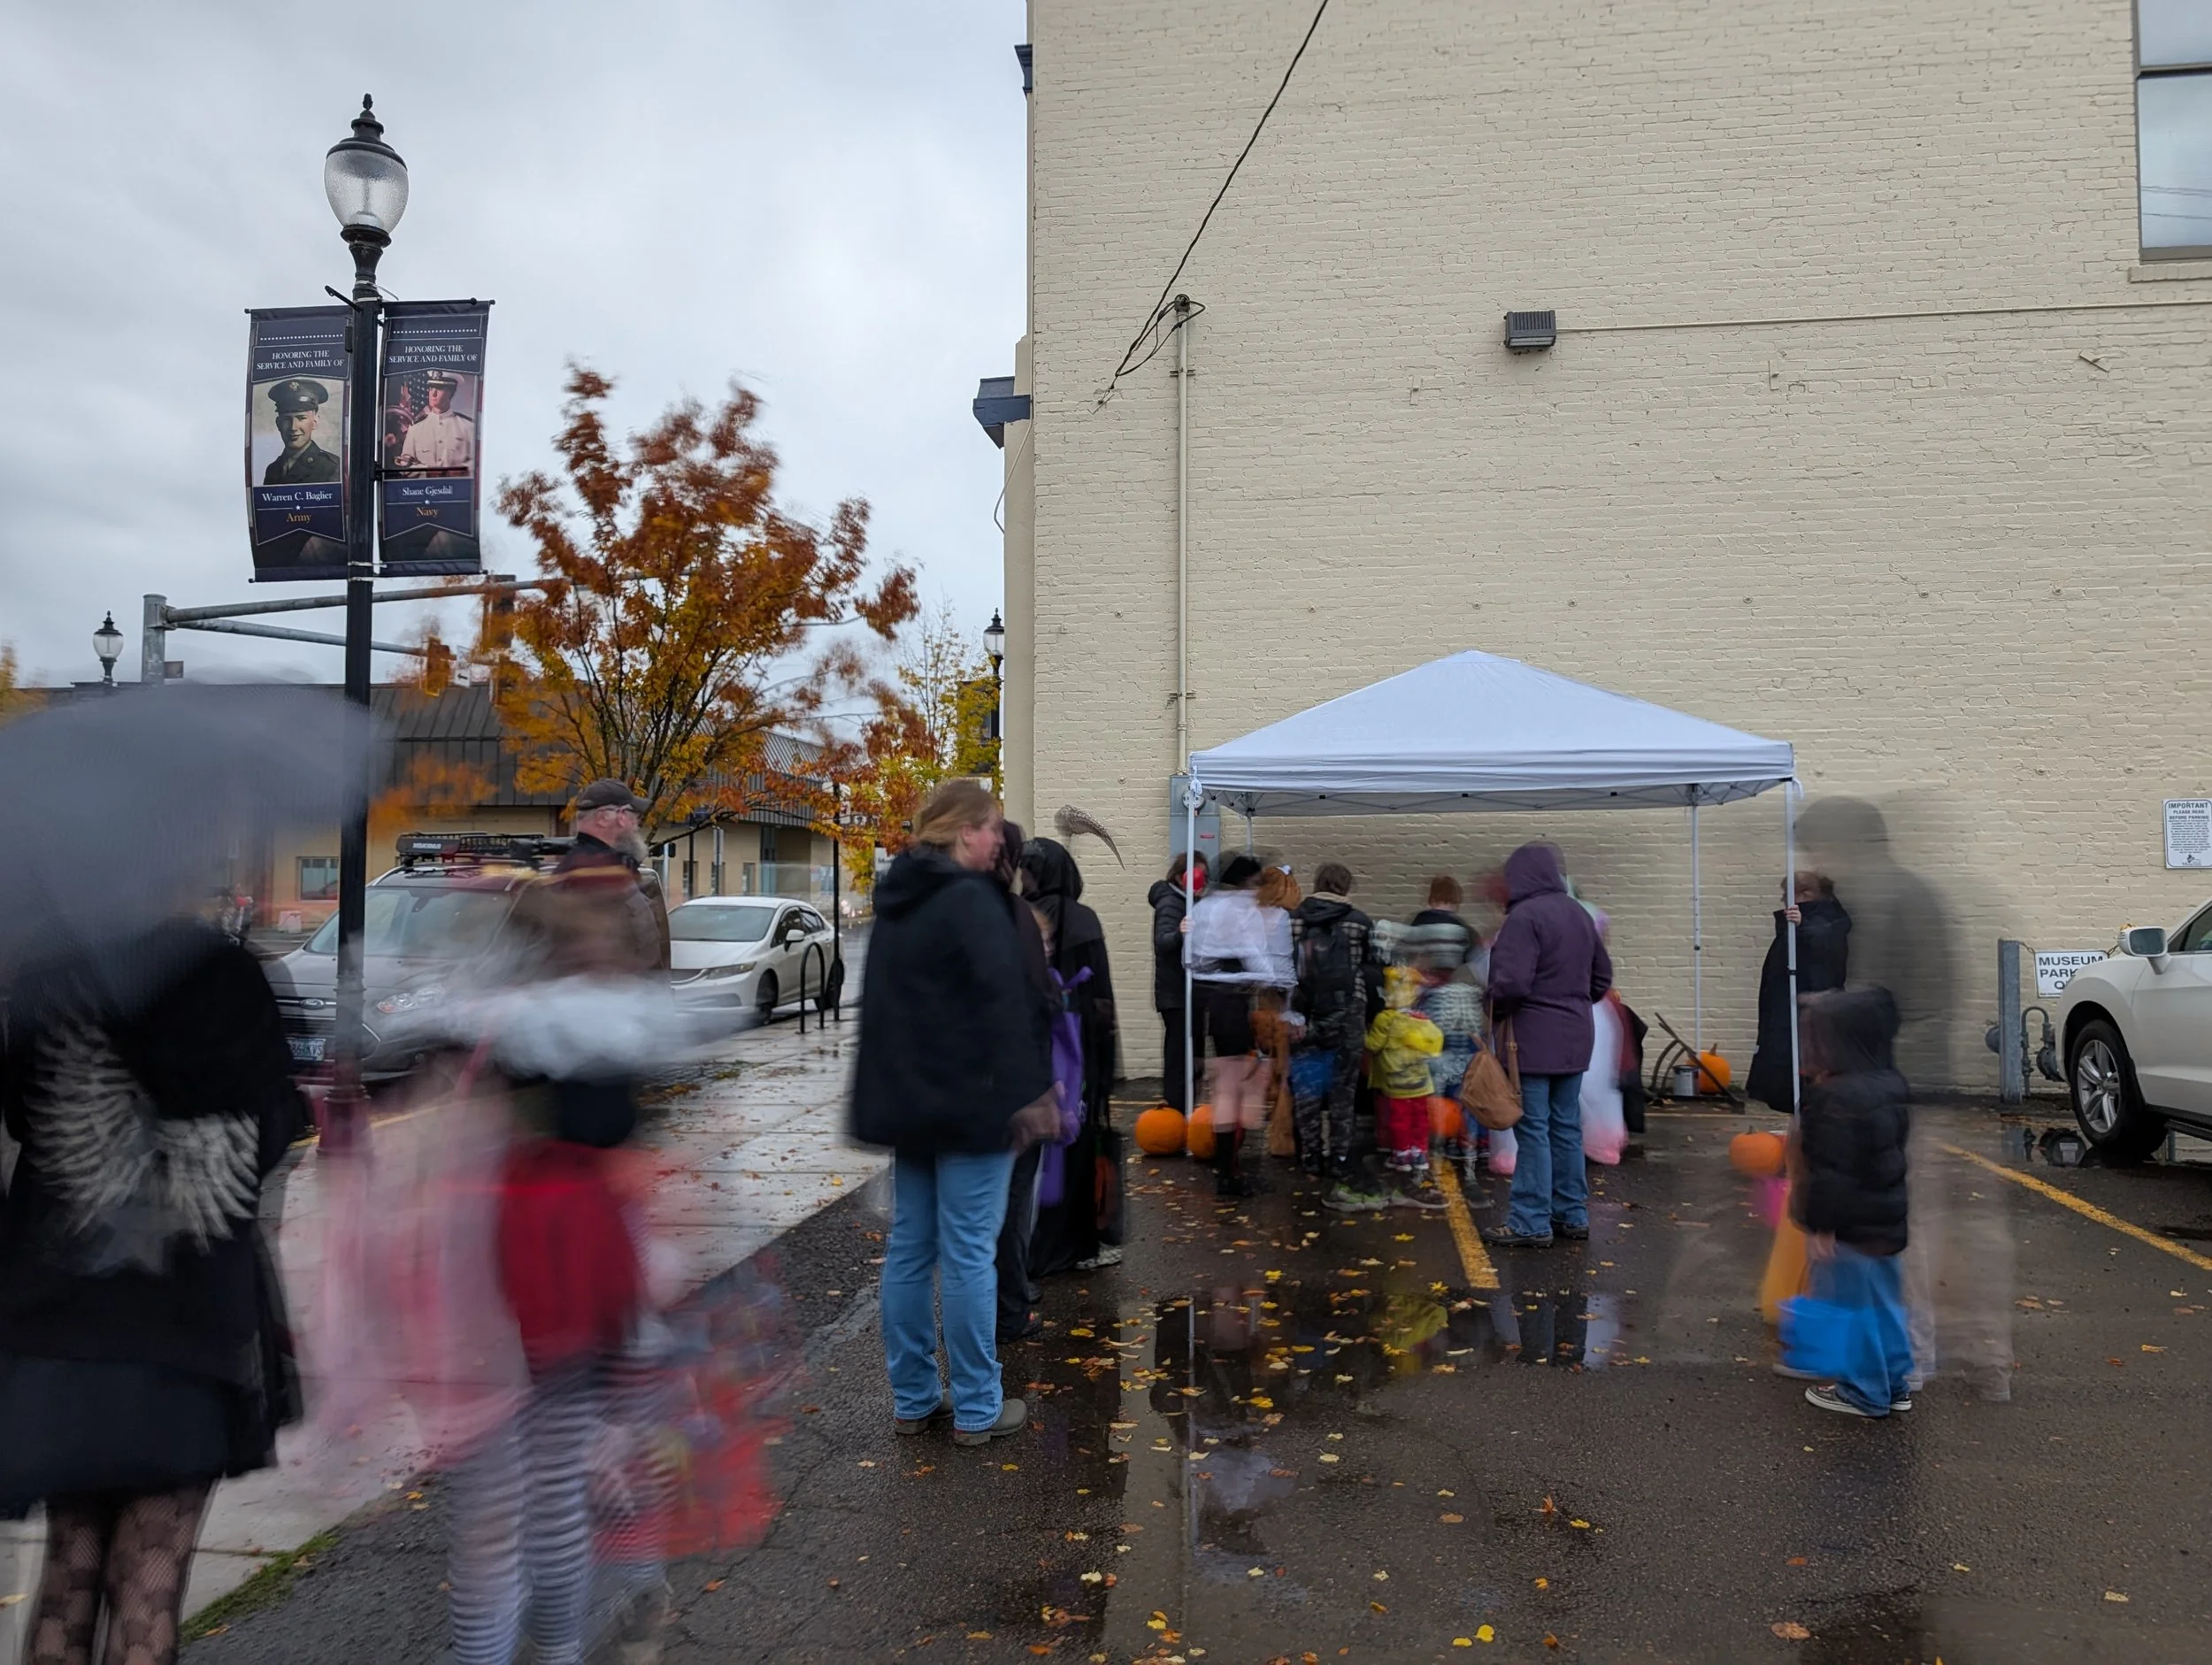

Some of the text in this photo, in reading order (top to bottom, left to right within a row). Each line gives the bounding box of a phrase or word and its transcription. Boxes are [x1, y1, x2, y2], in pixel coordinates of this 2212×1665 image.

[404, 345, 445, 354] HONORING
[272, 350, 312, 360] HONORING
[388, 355, 419, 364] SERVICE
[257, 361, 287, 370] SERVICE
[305, 359, 333, 368] FAMILY
[333, 358, 345, 367] OF
[402, 487, 424, 495] Shane
[262, 491, 333, 502] Warren C. Baglier
[416, 506, 439, 517] Navy
[286, 512, 311, 523] Army
[2039, 955, 2103, 966] MUSEUM
[2039, 968, 2079, 978] PARK
